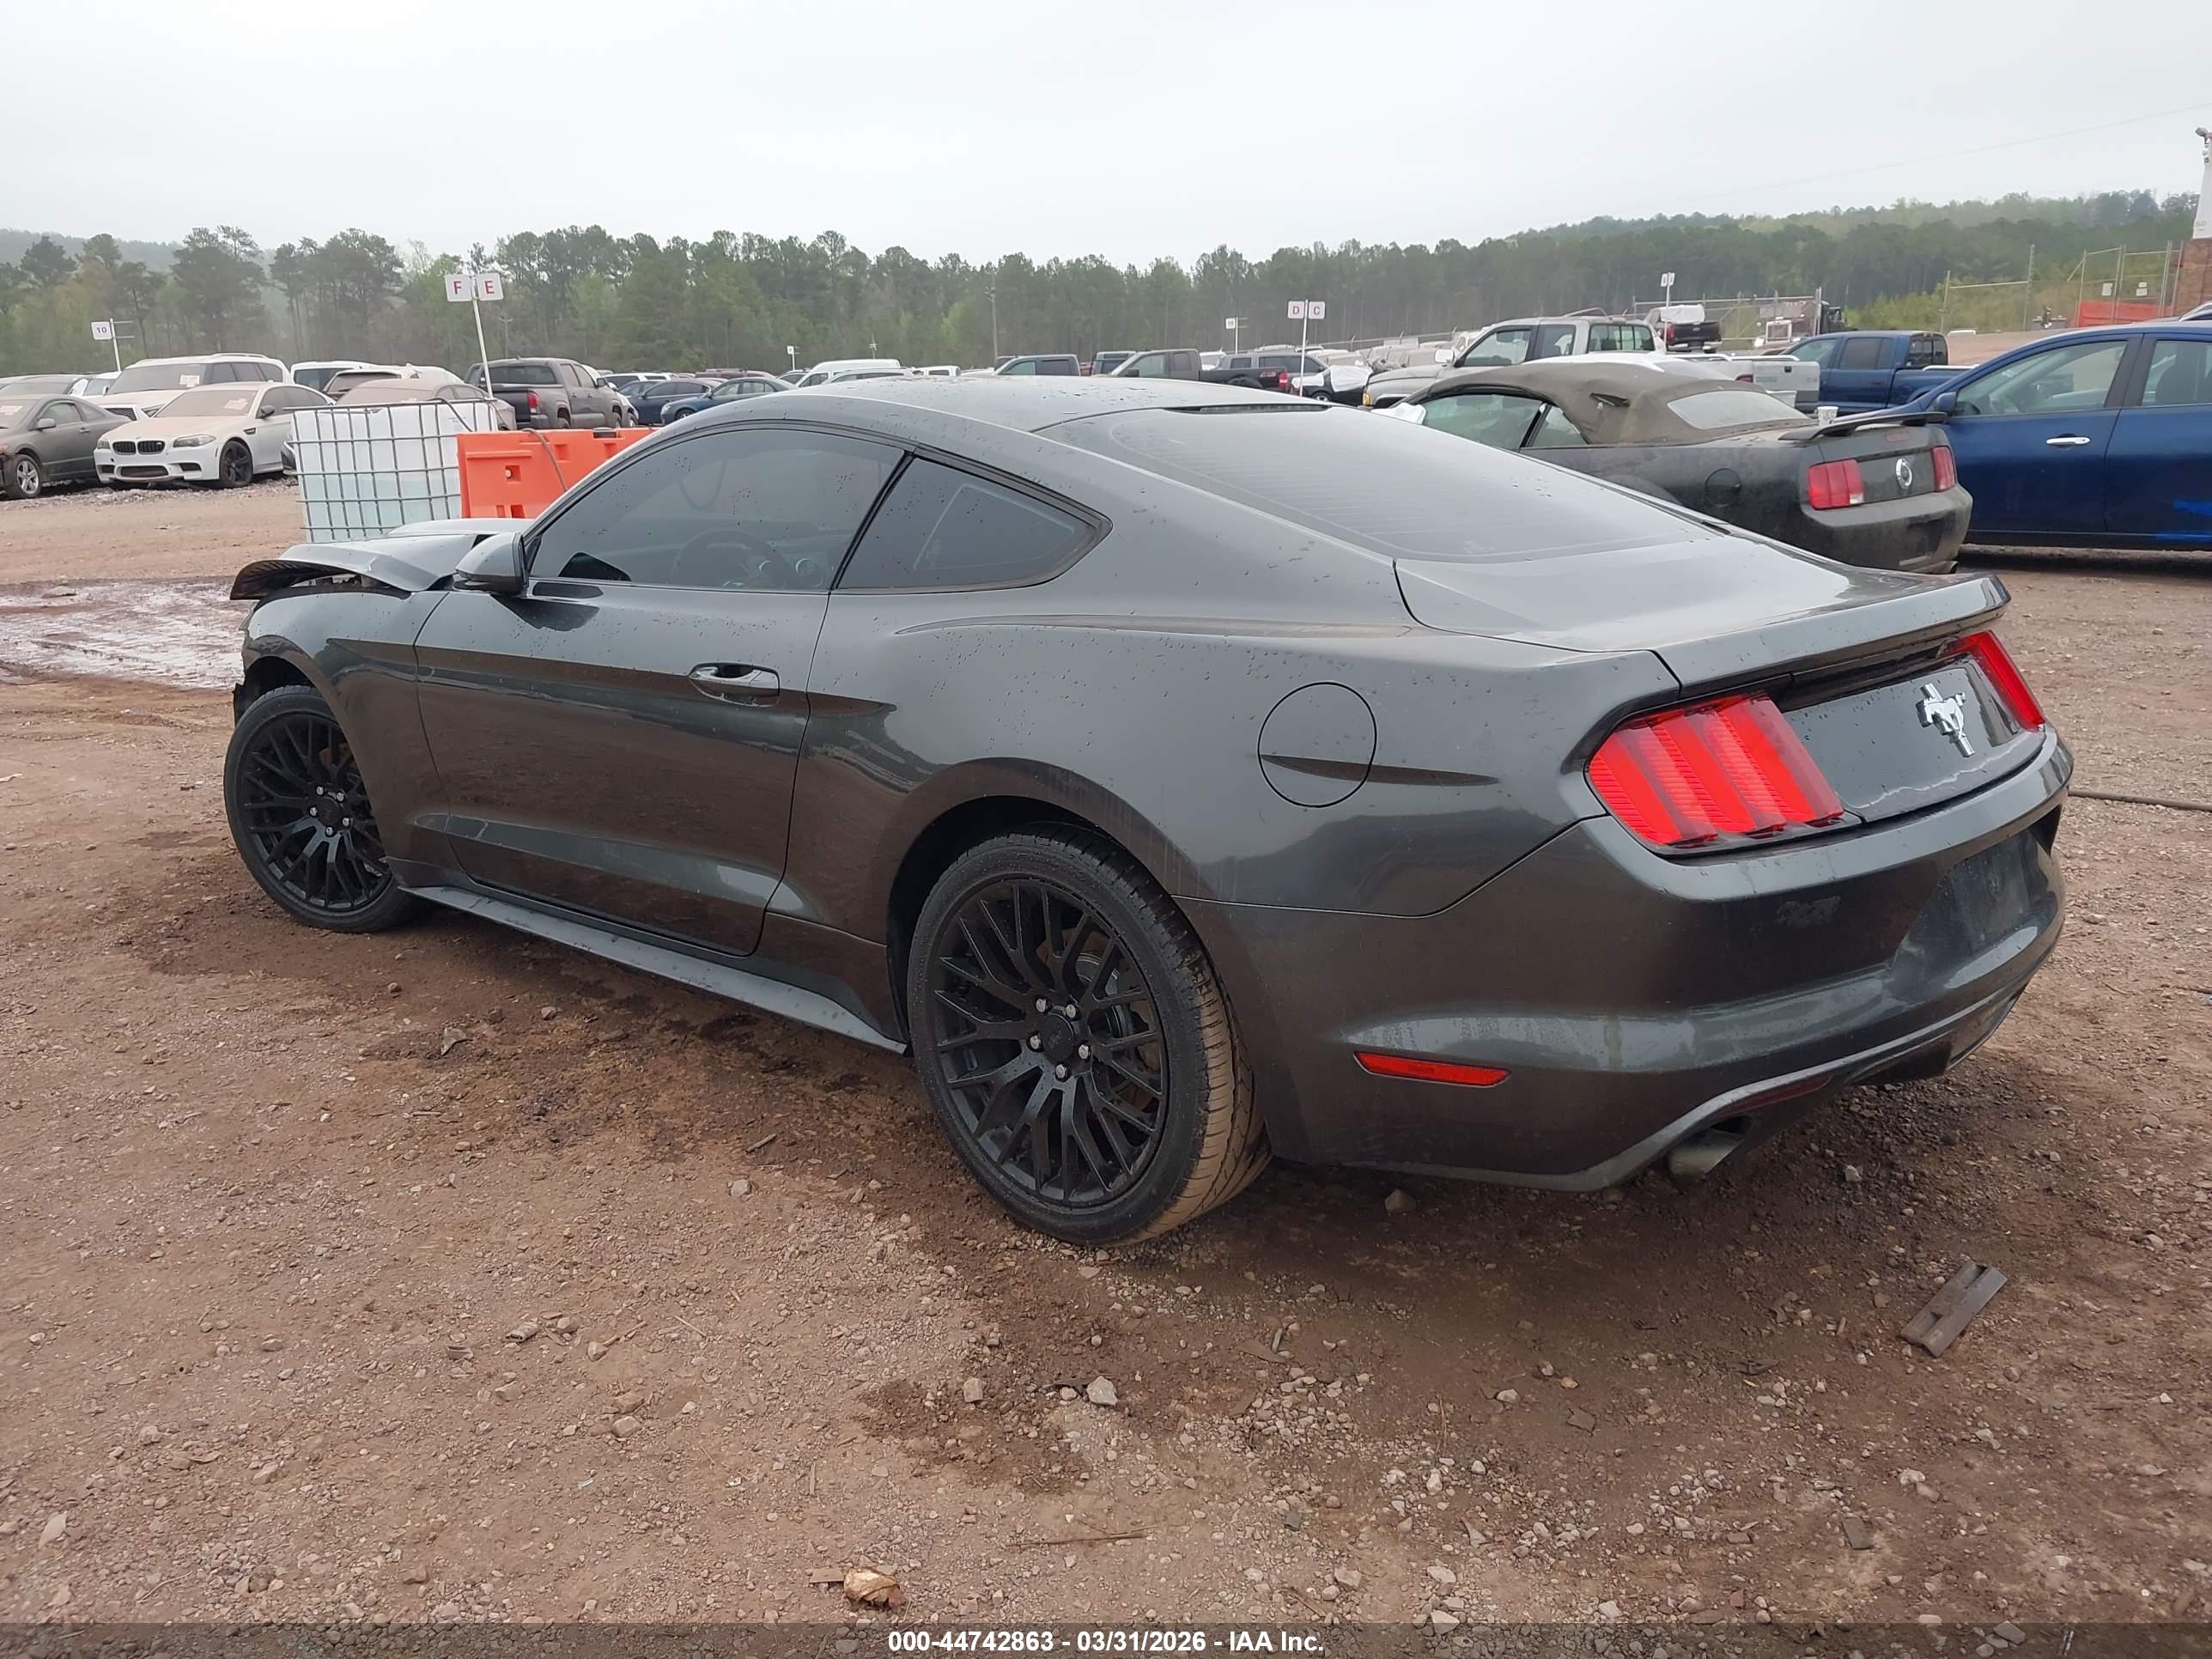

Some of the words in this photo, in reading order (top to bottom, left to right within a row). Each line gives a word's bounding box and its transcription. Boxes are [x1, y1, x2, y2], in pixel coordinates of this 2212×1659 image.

[453, 281, 462, 295] F
[484, 280, 495, 294] E
[1292, 306, 1300, 314] D
[1314, 307, 1321, 315] C
